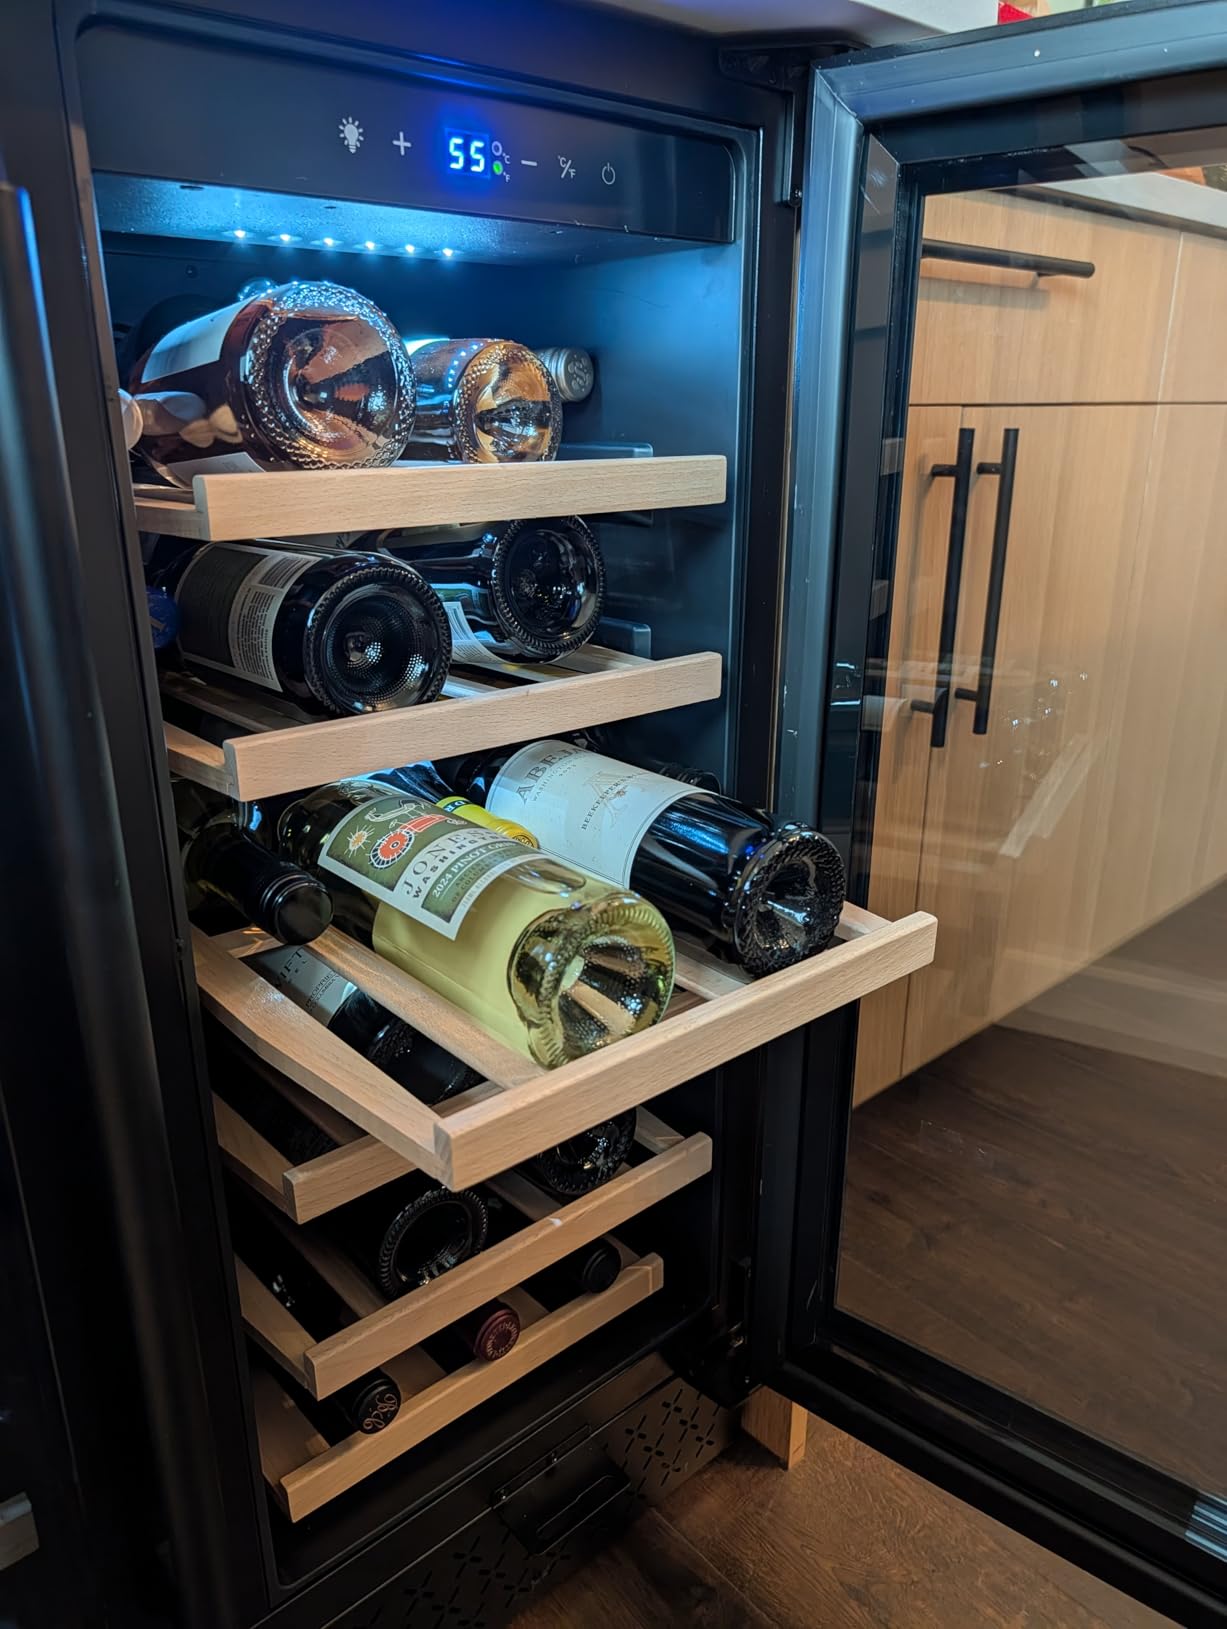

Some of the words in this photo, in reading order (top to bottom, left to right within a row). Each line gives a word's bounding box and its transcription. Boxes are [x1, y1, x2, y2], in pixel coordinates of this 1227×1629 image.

[449, 136, 485, 173] 55
[404, 829, 487, 897] JONES
[432, 873, 455, 899] 2024
[451, 846, 488, 878] PINOT
